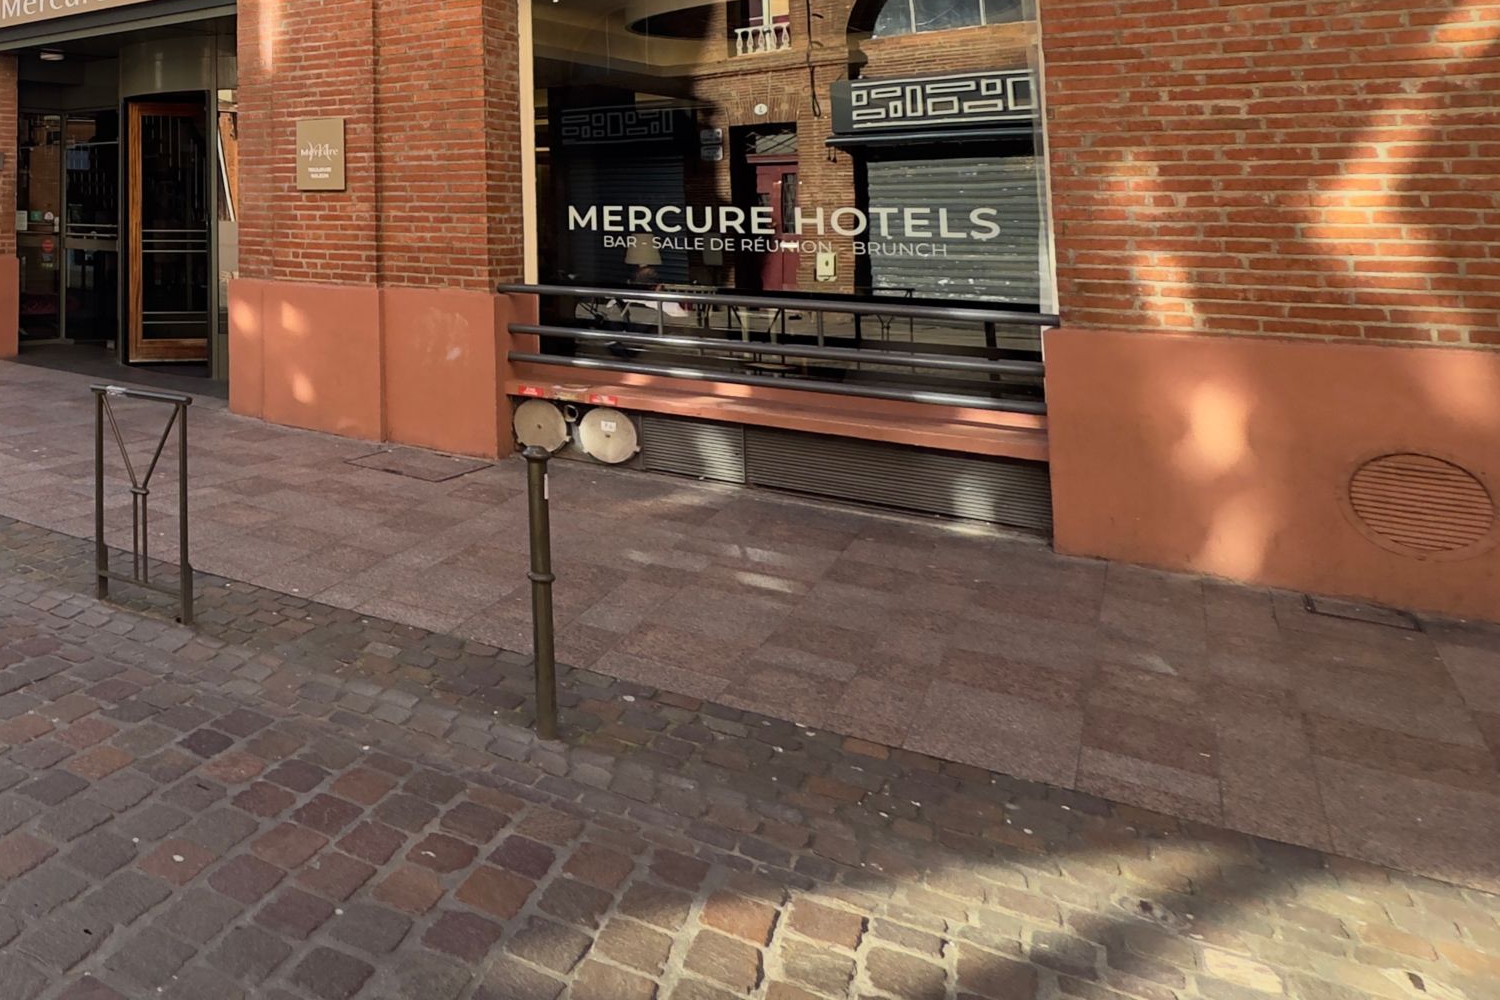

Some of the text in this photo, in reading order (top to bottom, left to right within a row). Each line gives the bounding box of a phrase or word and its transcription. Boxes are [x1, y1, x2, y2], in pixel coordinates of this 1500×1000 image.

[567, 204, 1001, 240] MERCURE HOTELS
[603, 235, 637, 248] BAR
[652, 236, 704, 250] SALLE
[710, 237, 735, 251] DE
[741, 236, 832, 253] RÉUNION
[852, 241, 947, 257] BRUNCH
